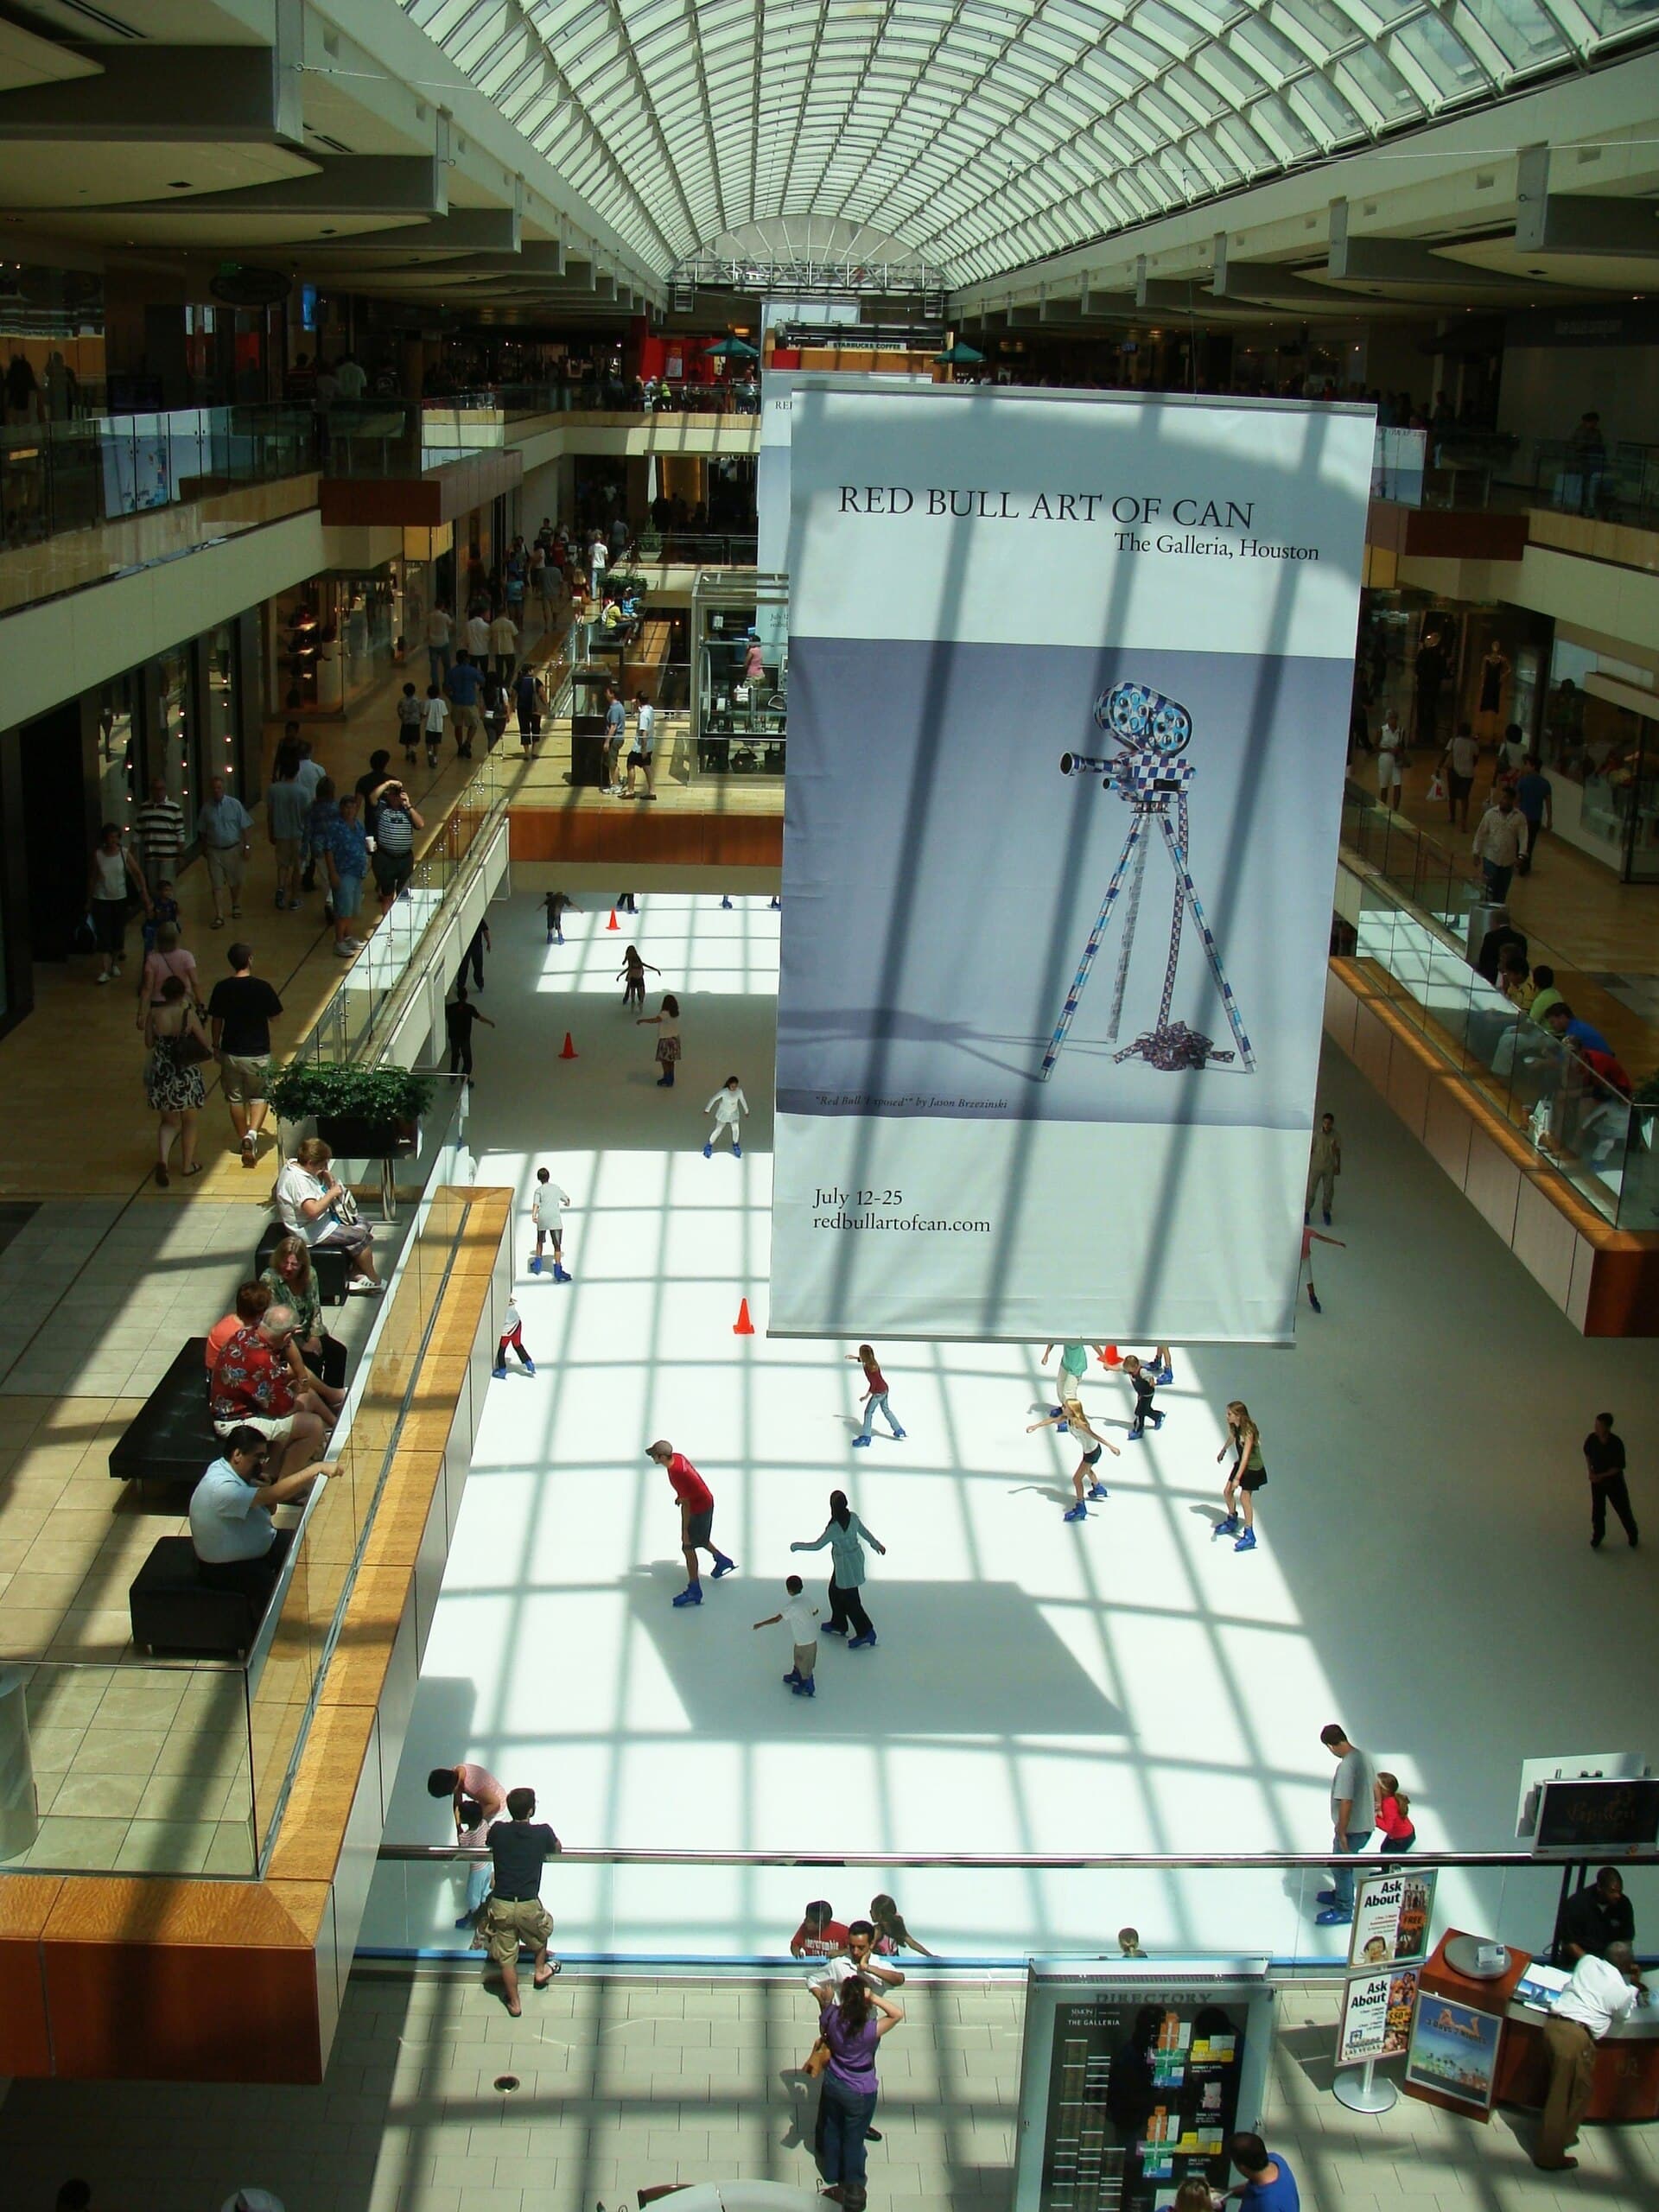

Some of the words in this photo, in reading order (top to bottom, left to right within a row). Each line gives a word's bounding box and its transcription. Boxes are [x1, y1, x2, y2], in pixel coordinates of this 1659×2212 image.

[838, 486, 914, 514] RED
[926, 488, 1020, 518] BULL
[1028, 493, 1103, 522] ART
[1111, 496, 1162, 524] OF
[1173, 499, 1255, 530] CAN
[1114, 531, 1151, 552] The
[1156, 534, 1234, 559] Galleria,
[1239, 538, 1319, 561] Houston
[916, 1096, 927, 1109] by
[929, 1096, 955, 1109] Jason
[812, 1187, 849, 1210] July
[856, 1189, 903, 1206] 12-25
[813, 1213, 991, 1232] redbullartofcan.com
[1381, 1880, 1402, 1894] Ask
[1363, 1893, 1401, 1908] About
[1367, 1980, 1388, 1994] Ask
[1096, 1993, 1212, 2005] DIRECTORY
[1351, 1993, 1387, 2009] About
